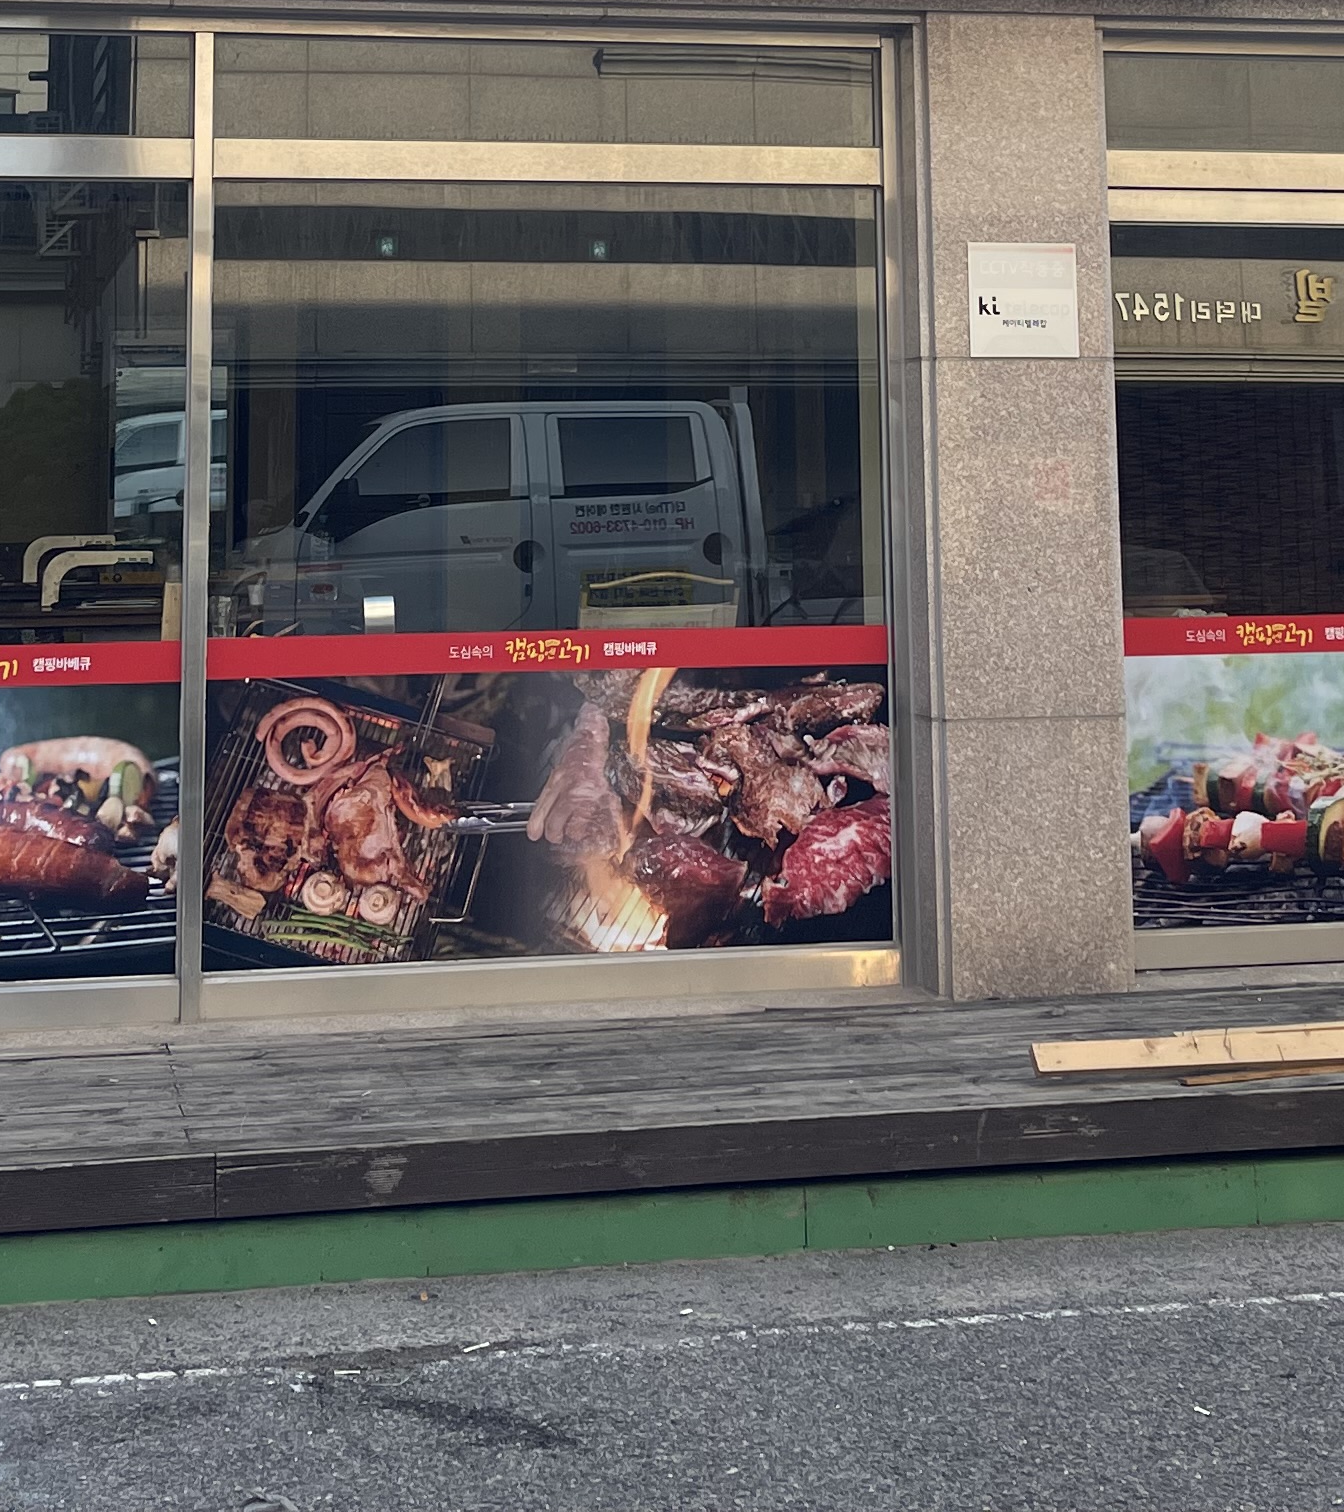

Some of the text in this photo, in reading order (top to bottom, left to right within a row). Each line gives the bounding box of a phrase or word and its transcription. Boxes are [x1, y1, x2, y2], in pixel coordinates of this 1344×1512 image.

[1185, 628, 1226, 643] 도심속의
[449, 644, 493, 659] 도심속의
[603, 641, 657, 656] 캠핑바베큐
[32, 657, 91, 672] 캠핑바베큐
